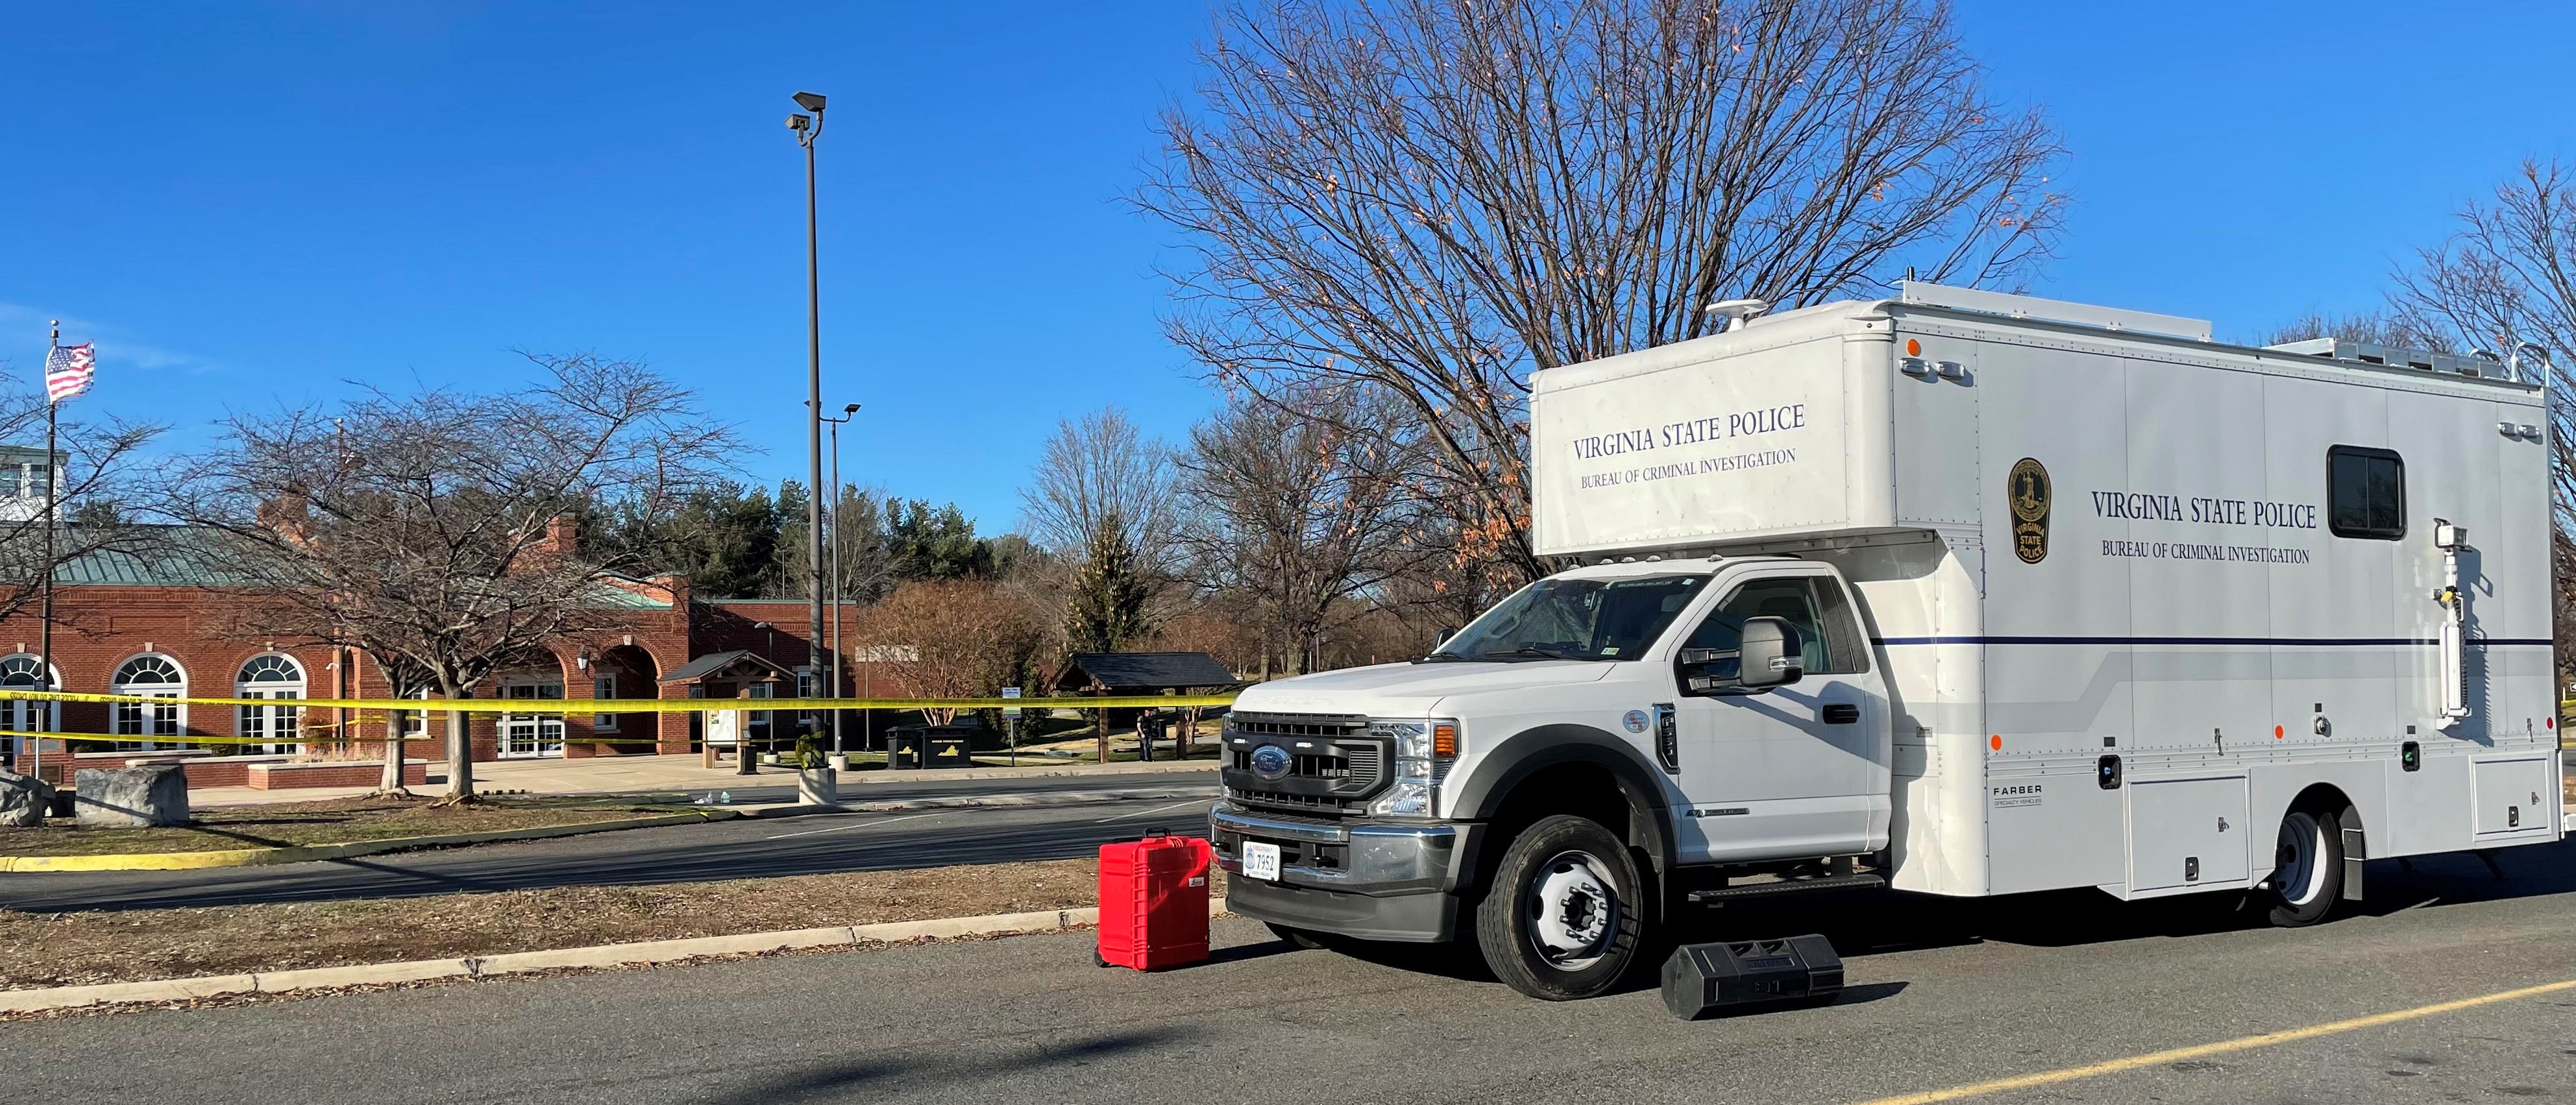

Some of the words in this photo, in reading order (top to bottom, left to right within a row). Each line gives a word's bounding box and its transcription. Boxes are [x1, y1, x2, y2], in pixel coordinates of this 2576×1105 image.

[1573, 428, 1655, 459] VIRGINIA
[1663, 417, 1720, 448] STATE
[1729, 404, 1805, 437] POLICE
[1581, 472, 1622, 489] BUREAU
[1625, 469, 1639, 483] OF
[1643, 462, 1697, 481] CRIMINAL
[1700, 448, 1796, 474] INVESTIGATION
[2092, 491, 2183, 521] VIRGINIA
[2191, 497, 2246, 524] STATE
[2253, 502, 2316, 529] POLICE
[2016, 522, 2045, 537] VIRGINIA
[2020, 535, 2041, 545] STATE
[2019, 545, 2043, 558] POLICE
[2102, 540, 2149, 557] BUREAU
[2153, 542, 2168, 558] OF
[2172, 543, 2225, 561] CRIMINAL
[2228, 546, 2309, 564] INVESTIGATION
[10, 692, 27, 700] CROSS
[1258, 754, 1277, 770] Ford
[1993, 785, 2042, 795] FARBER
[1257, 854, 1274, 871] 7952
